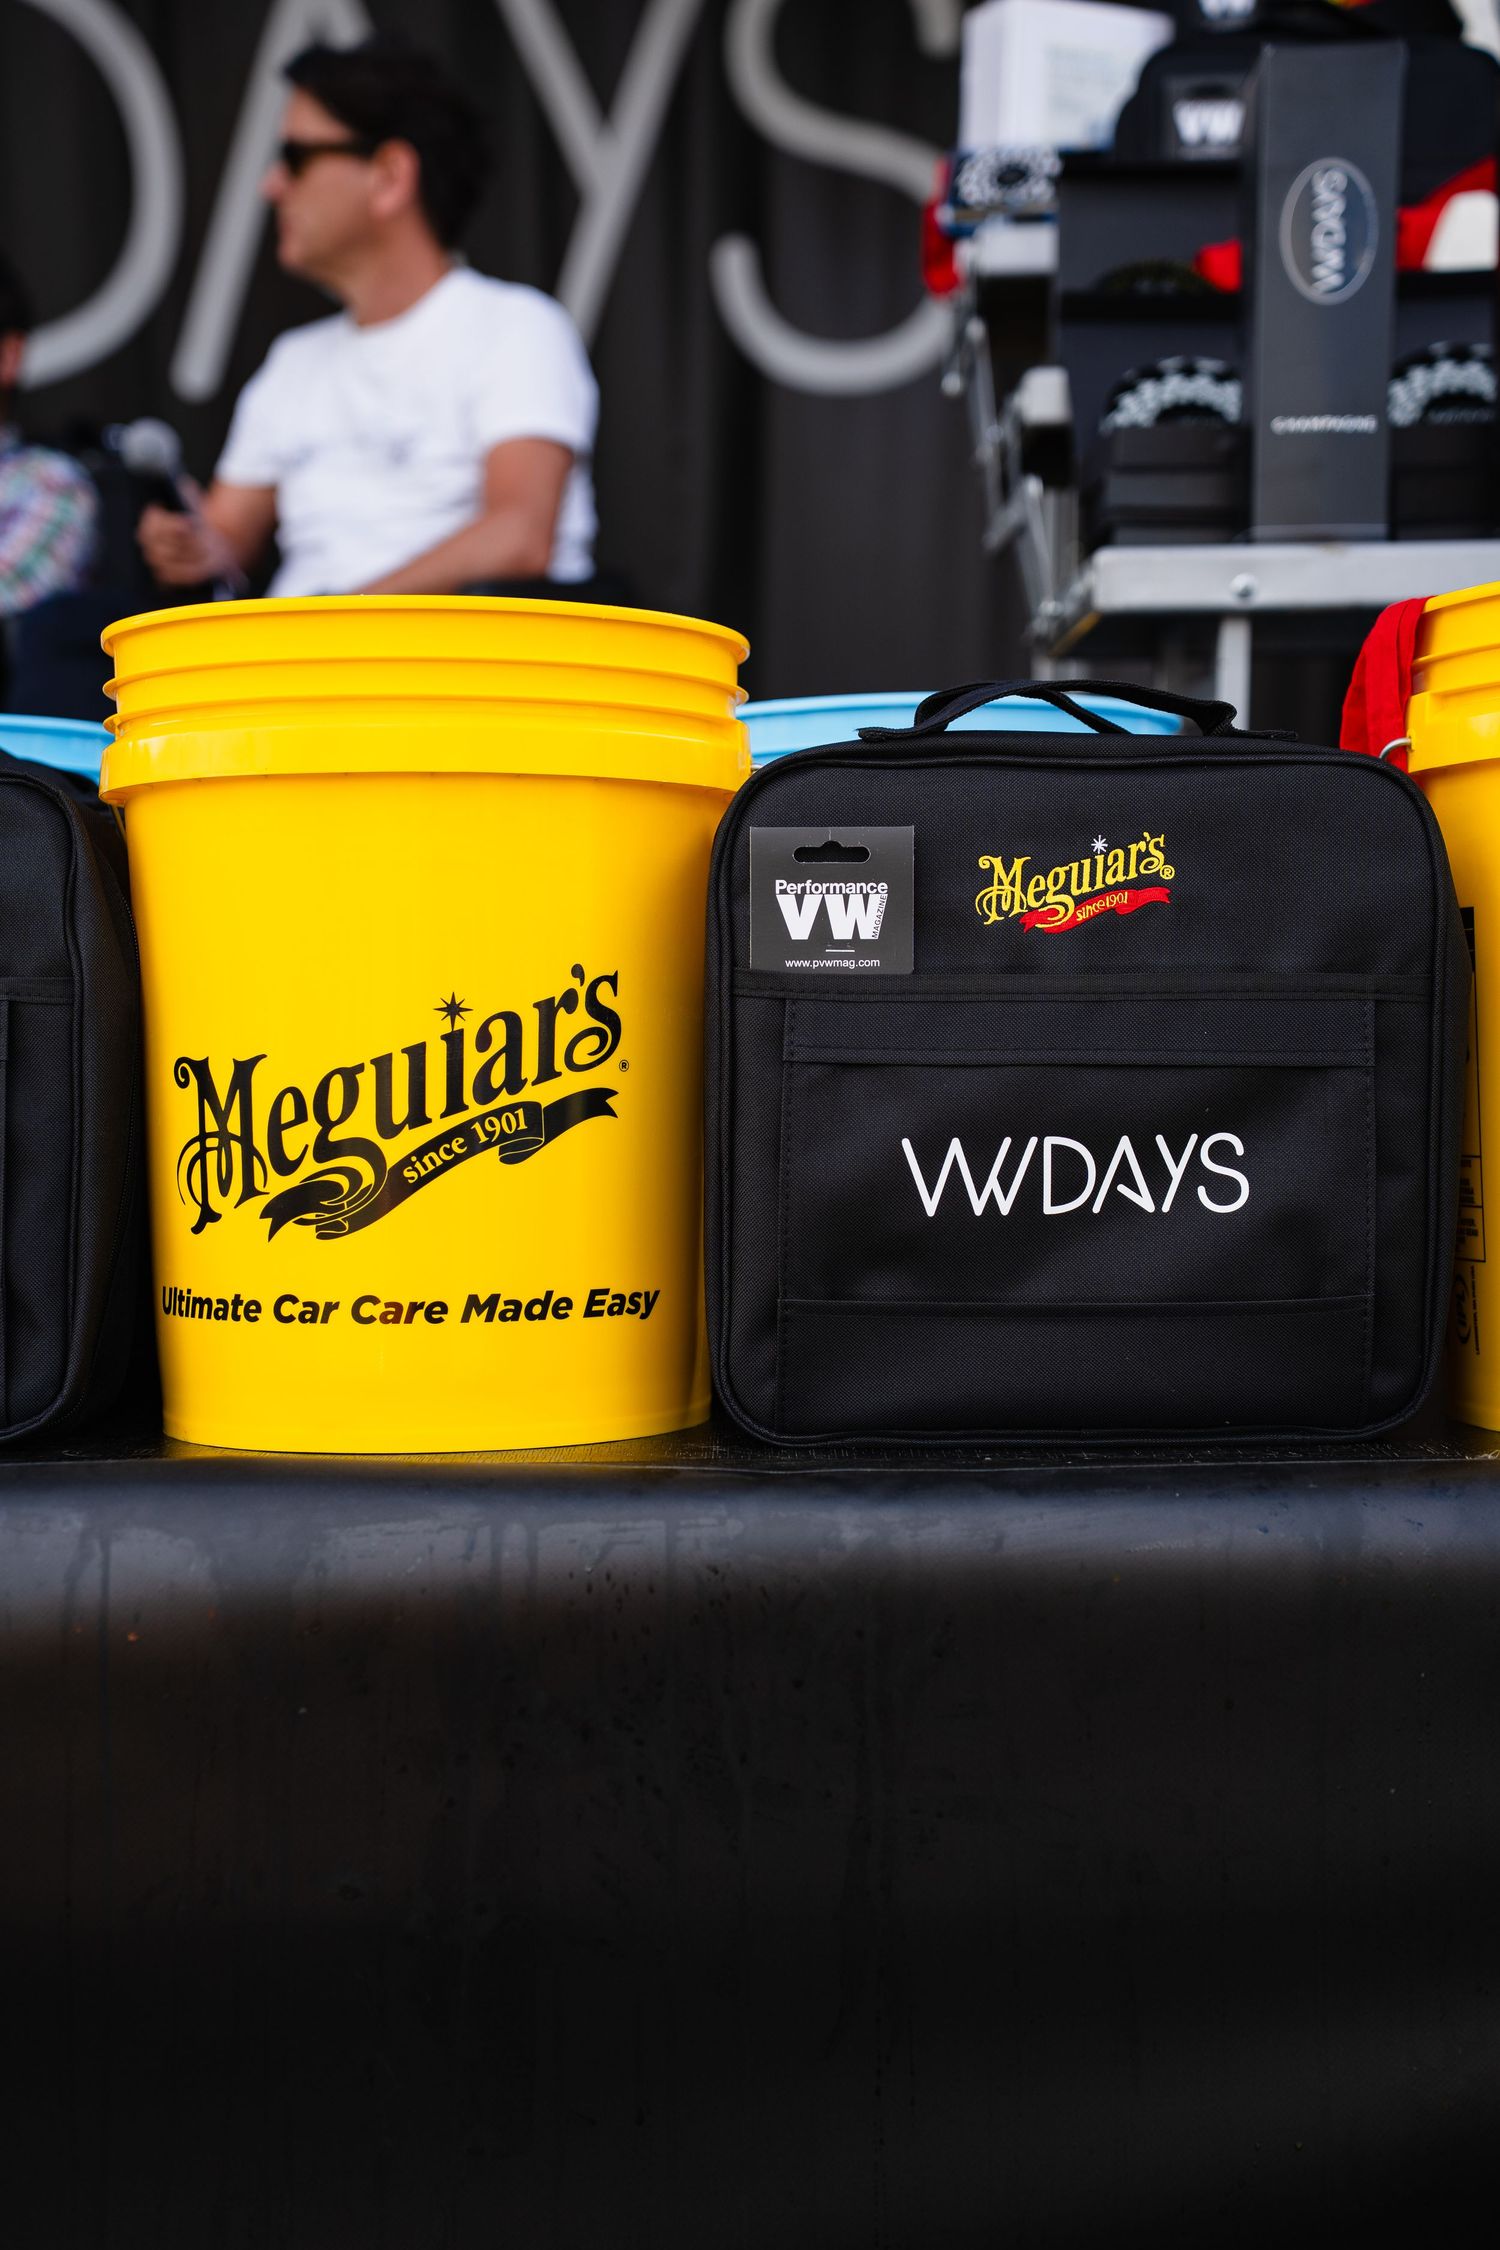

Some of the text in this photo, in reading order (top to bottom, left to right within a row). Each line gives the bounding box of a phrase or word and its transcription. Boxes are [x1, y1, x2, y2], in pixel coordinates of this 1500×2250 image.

[774, 879, 889, 895] Performance
[975, 831, 1167, 929] Meguiar's
[775, 893, 889, 941] VW
[871, 894, 887, 939] MAGAZINE
[1075, 891, 1129, 922] since 1901
[784, 958, 881, 970] www.pvwmag.com
[173, 962, 622, 1236] Meguiar's
[402, 1107, 529, 1185] since 1901
[160, 1285, 661, 1325] Ultimate Car Care Made Easy
